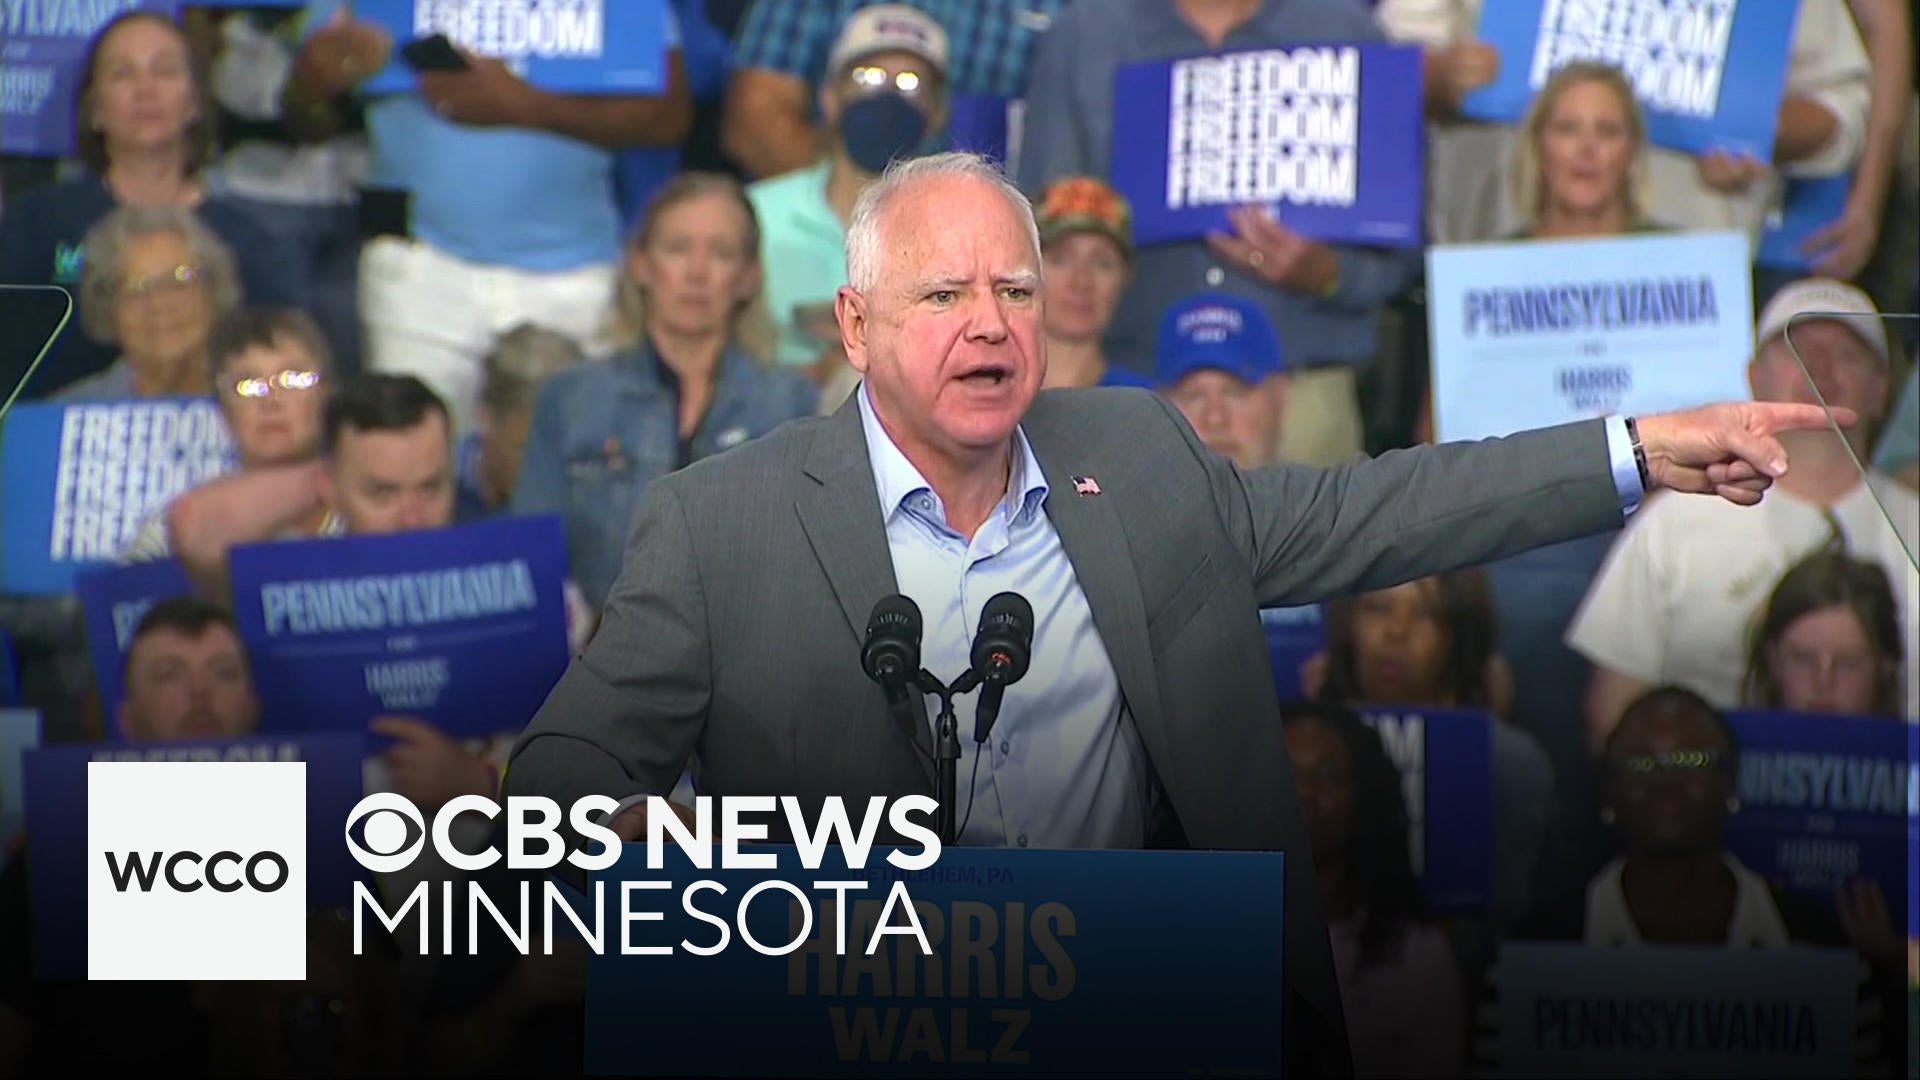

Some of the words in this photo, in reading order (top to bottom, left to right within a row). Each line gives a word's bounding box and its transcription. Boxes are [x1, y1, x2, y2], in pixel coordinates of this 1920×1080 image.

[1170, 46, 1360, 108] FREEDOM
[1168, 93, 1358, 159] FREEDOM
[1166, 143, 1356, 209] FREEDOM
[1461, 272, 1719, 339] PENNSYLVANIA
[260, 558, 537, 636] PENNSYLVANIA
[363, 657, 449, 694] HARRIS
[988, 867, 1015, 883] PA
[786, 899, 1078, 1001] HARRIS
[827, 1005, 1033, 1065] WALZ
[1536, 996, 1818, 1053] PENNSYLVANIA
